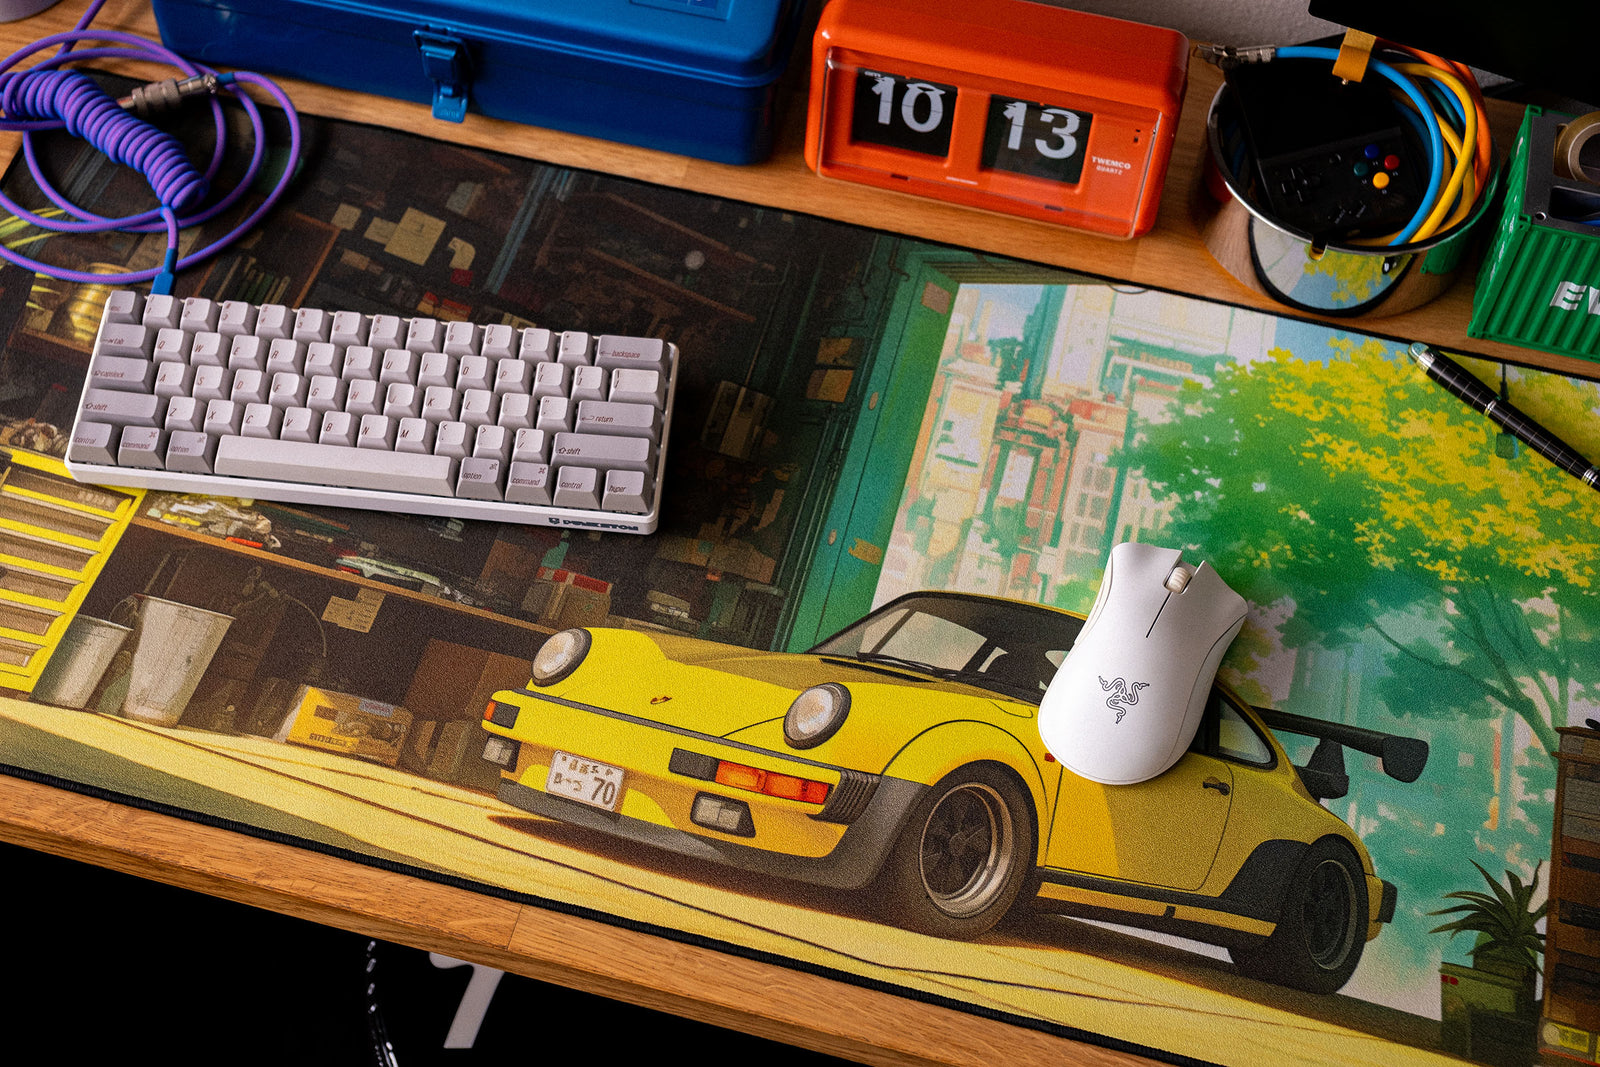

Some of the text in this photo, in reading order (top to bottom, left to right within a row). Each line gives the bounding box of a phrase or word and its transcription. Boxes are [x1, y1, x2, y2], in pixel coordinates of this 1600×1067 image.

[871, 76, 946, 133] 10
[1003, 101, 1080, 160] 13
[1092, 155, 1131, 170] TWEMCO
[1096, 165, 1123, 175] QUARTZ
[195, 344, 203, 353] W
[233, 347, 240, 356] E
[271, 350, 279, 359] R
[309, 353, 315, 362] T
[611, 350, 641, 359] backspace
[347, 357, 355, 366] Y
[385, 361, 393, 369] U
[160, 374, 167, 382] A
[500, 370, 507, 379] P
[198, 377, 204, 385] S
[236, 381, 244, 390] D
[274, 384, 280, 393] F
[312, 388, 319, 397] G
[351, 392, 359, 400] H
[428, 398, 435, 406] K
[169, 408, 177, 417] Z
[208, 411, 217, 419] X
[246, 415, 254, 424] C
[286, 419, 293, 427] V
[595, 415, 614, 423] return
[361, 427, 369, 435] N
[400, 430, 409, 438] M
[122, 442, 150, 450] command
[170, 446, 190, 454] option
[463, 472, 482, 480] option
[512, 478, 540, 486] command
[608, 485, 627, 493] hyper
[591, 776, 615, 805] 70
